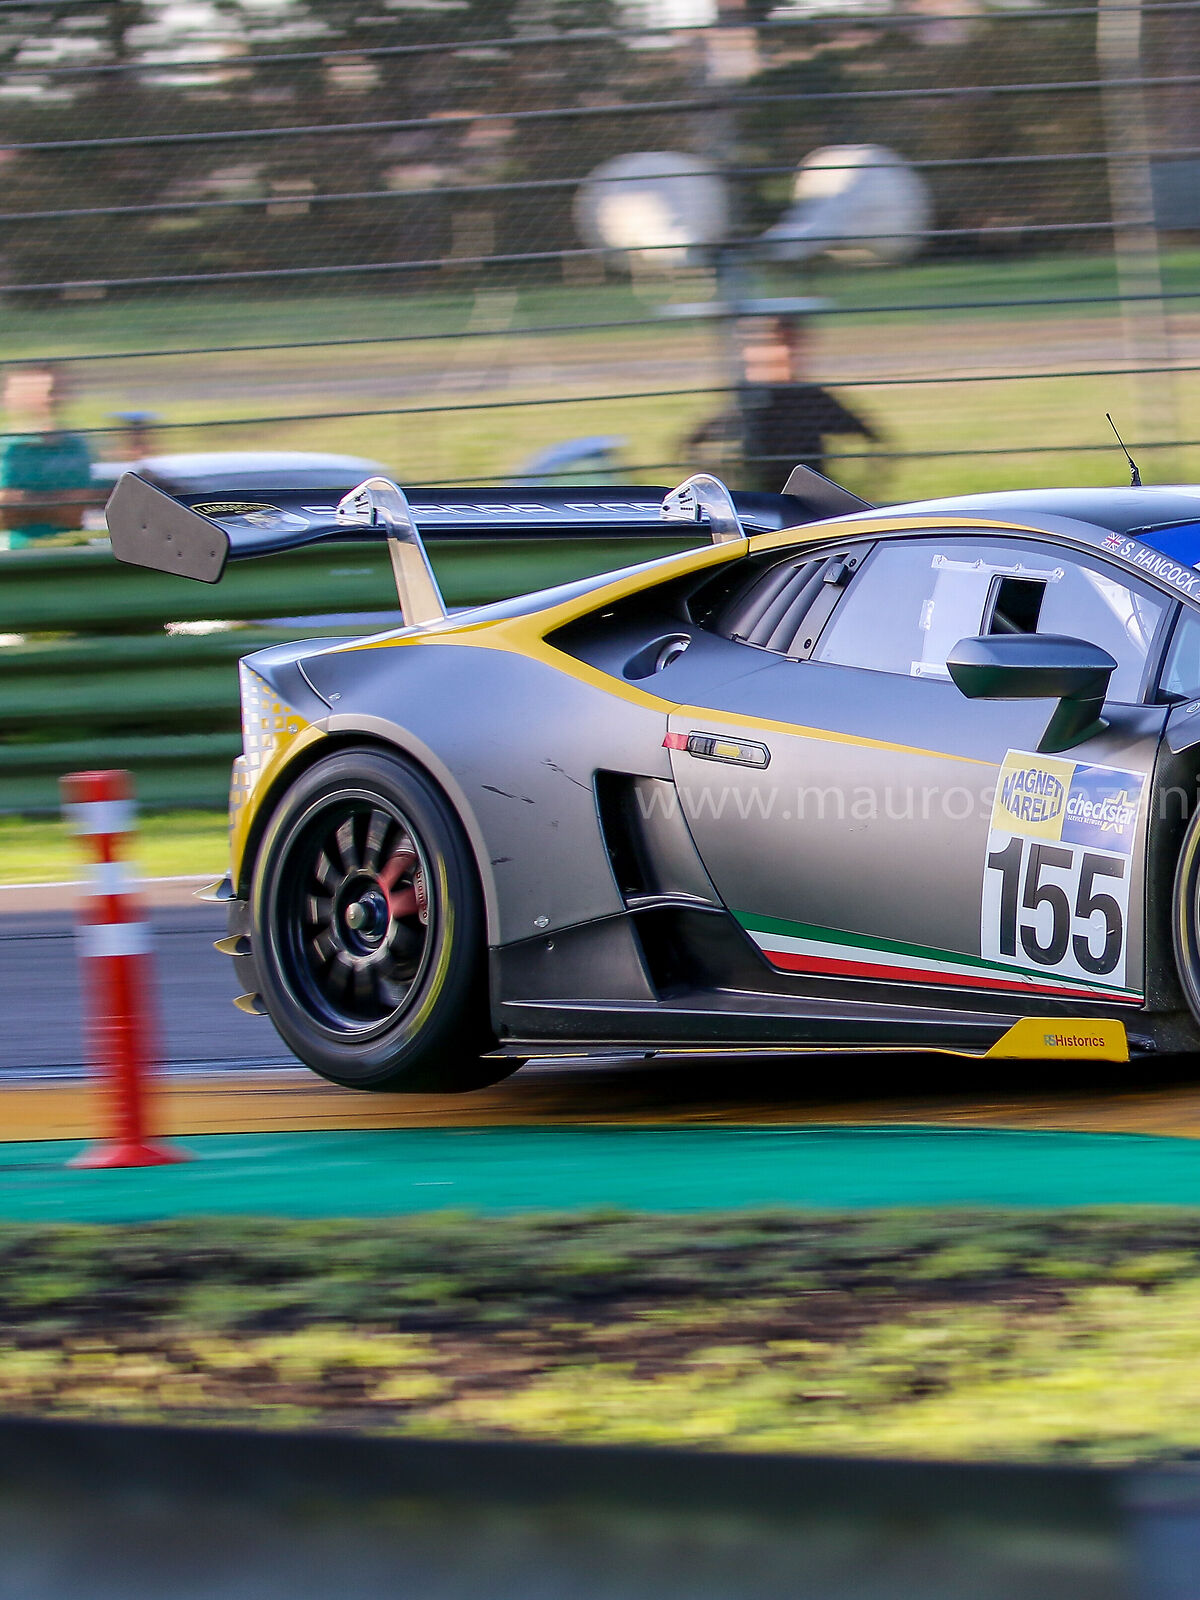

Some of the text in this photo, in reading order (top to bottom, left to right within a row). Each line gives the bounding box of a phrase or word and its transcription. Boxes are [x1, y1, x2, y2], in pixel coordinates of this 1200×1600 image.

[1121, 541, 1200, 592] S. HANCOCK
[1001, 768, 1065, 801] MAGNETI
[1000, 790, 1065, 822] MARELLI
[1066, 792, 1137, 826] checkstar
[988, 836, 1126, 975] 155
